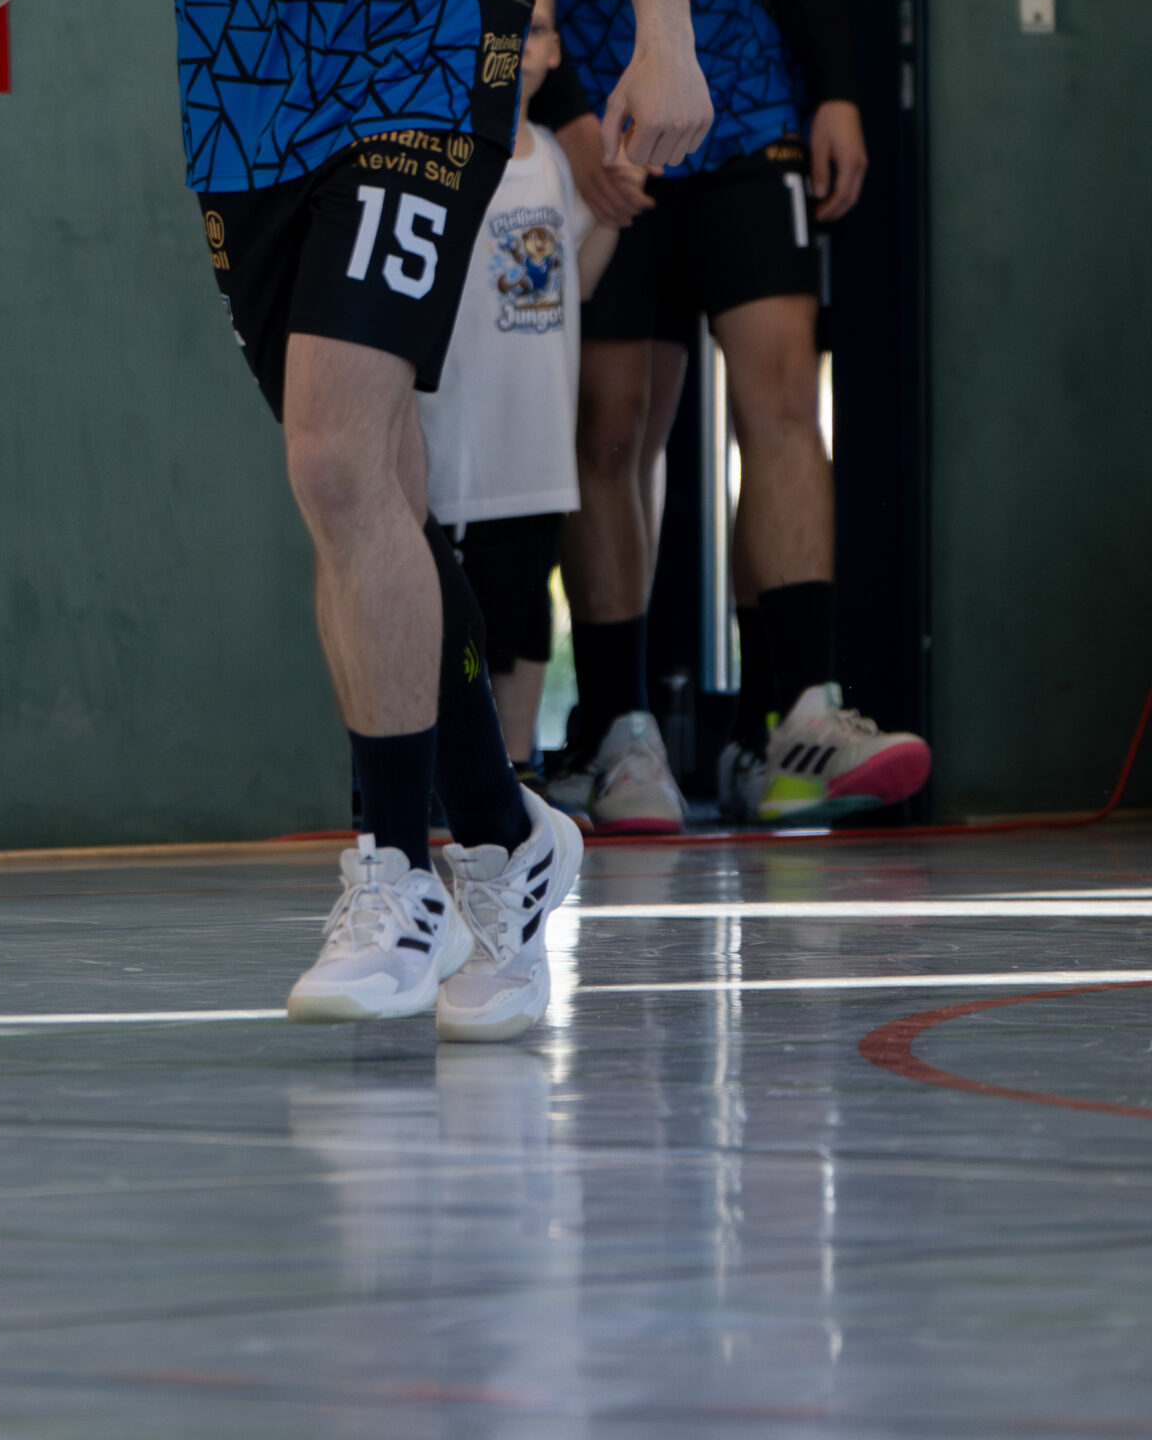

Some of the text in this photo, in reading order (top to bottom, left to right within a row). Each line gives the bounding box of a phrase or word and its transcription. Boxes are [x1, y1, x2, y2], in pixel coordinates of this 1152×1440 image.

[482, 51, 519, 84] OTTER
[423, 159, 462, 191] Stoll
[346, 184, 448, 300] 15
